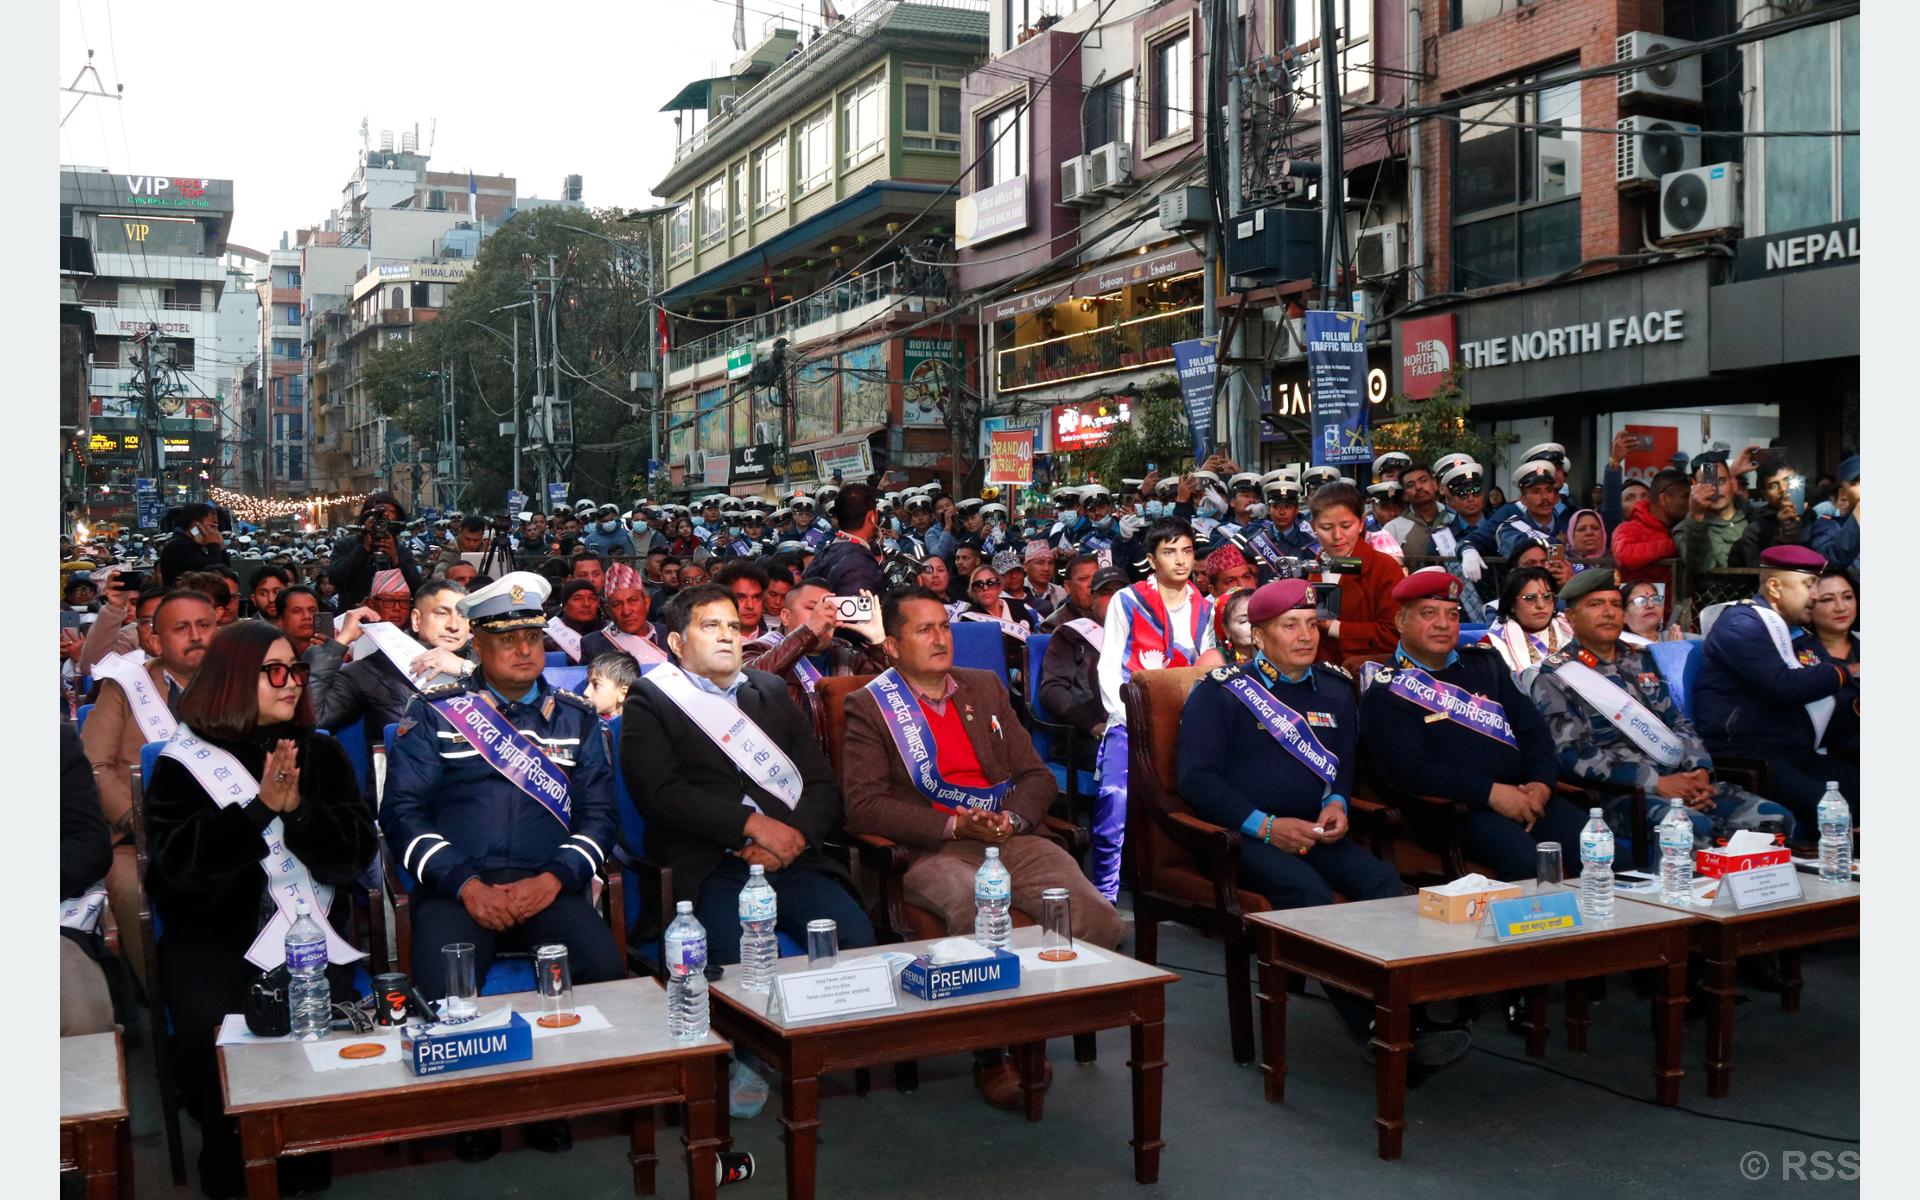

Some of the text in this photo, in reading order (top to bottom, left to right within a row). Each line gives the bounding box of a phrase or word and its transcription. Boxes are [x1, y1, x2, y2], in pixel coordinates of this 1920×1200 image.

[127, 176, 170, 196] VIP
[180, 188, 206, 198] TOP
[125, 223, 150, 242] VIP
[1765, 227, 1860, 270] NEPAL
[159, 322, 190, 333] HOTEL
[388, 332, 402, 340] SPA
[1321, 331, 1350, 342] FOLLOW
[1460, 309, 1684, 368] THE NORTH FACE
[936, 340, 952, 351] CAF
[1310, 341, 1363, 352] TRAFFIC RULES
[1416, 340, 1433, 353] THE
[1188, 354, 1215, 368] FOLLOW
[1404, 352, 1433, 367] NORTH
[1180, 366, 1207, 379] TRAFFIC
[1412, 363, 1433, 376] FACE
[1017, 462, 1031, 480] off
[931, 964, 1000, 990] PREMIUM
[419, 1034, 507, 1063] PREMIUM
